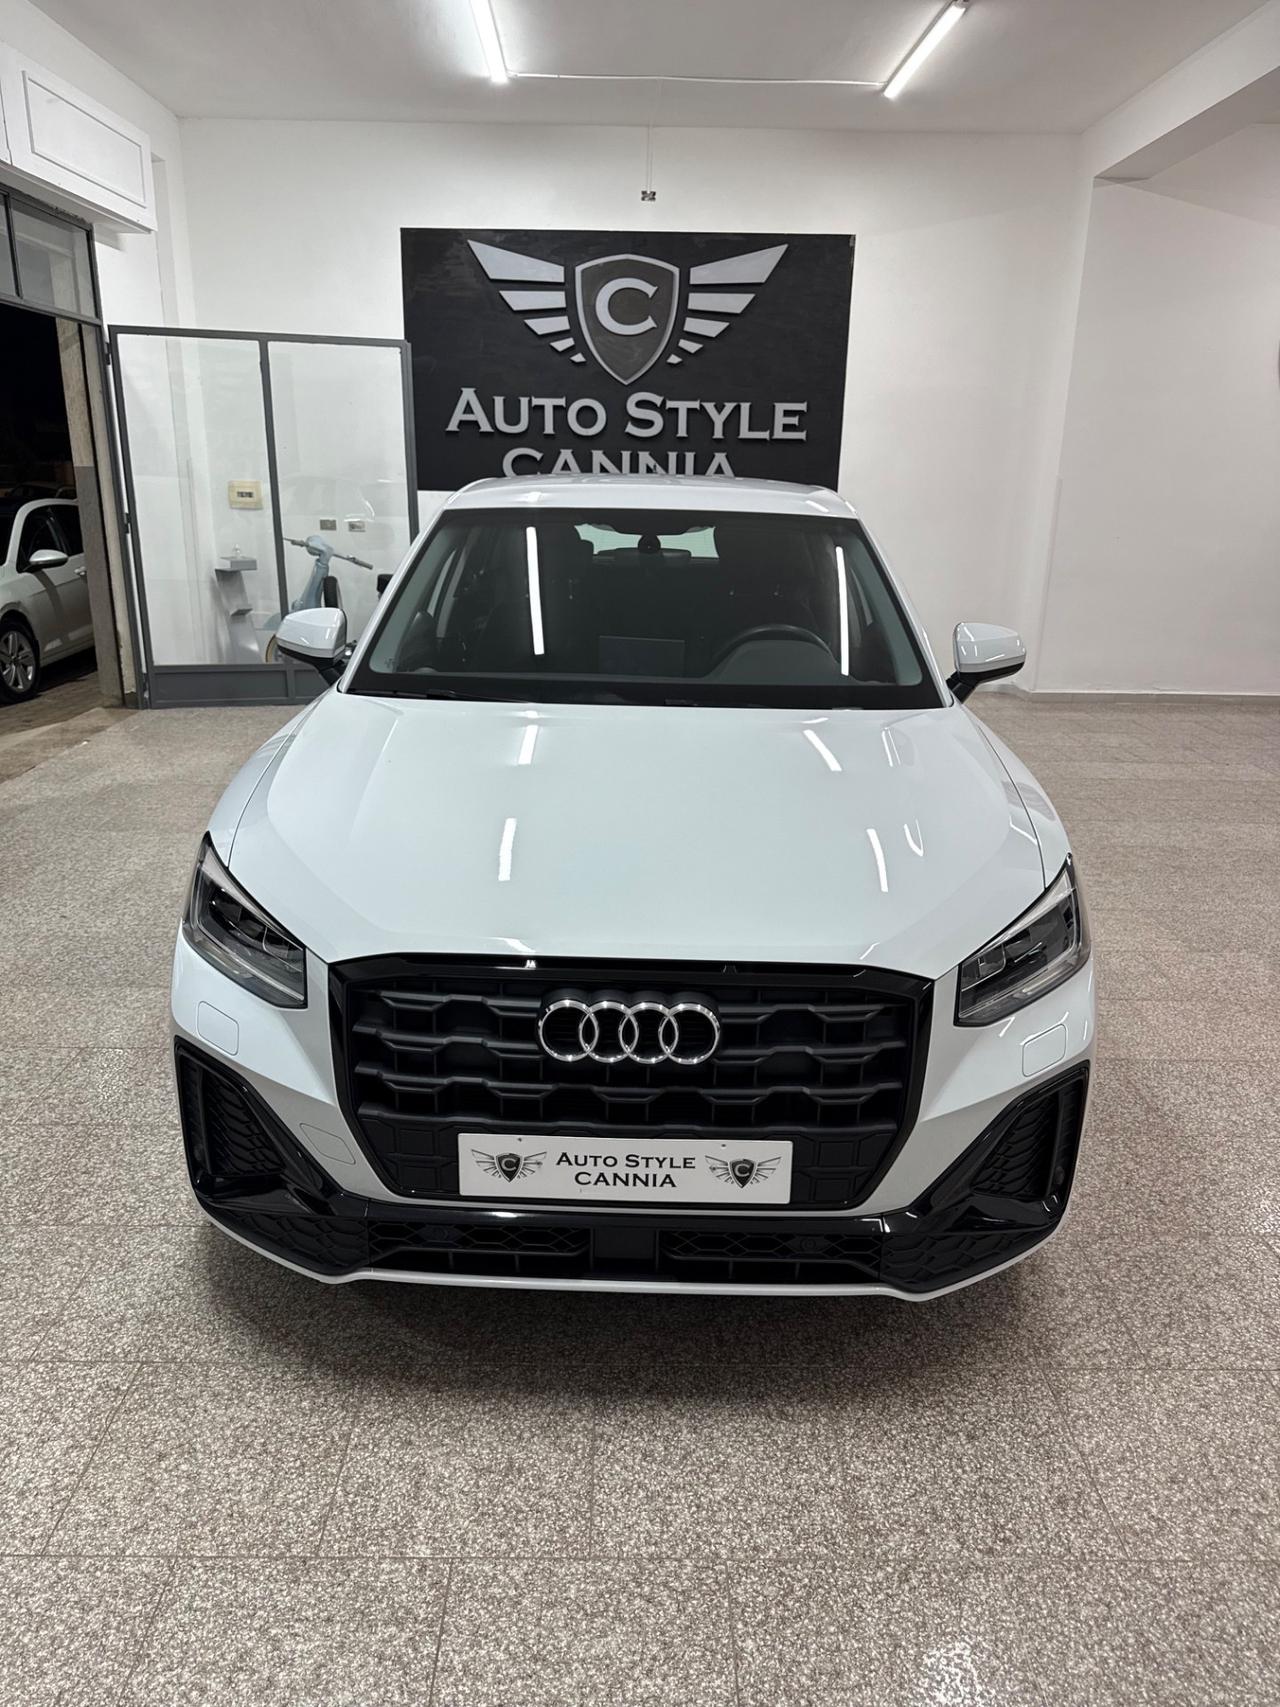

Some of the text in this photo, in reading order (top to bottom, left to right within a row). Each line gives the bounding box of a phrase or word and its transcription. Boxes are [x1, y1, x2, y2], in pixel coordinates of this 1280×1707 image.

[595, 277, 658, 336] C
[445, 387, 808, 441] AUTO STYLE
[501, 1157, 517, 1171] C
[556, 1152, 696, 1169] AUTO STYLE
[735, 1163, 750, 1177] C
[574, 1171, 677, 1187] CANNIA
